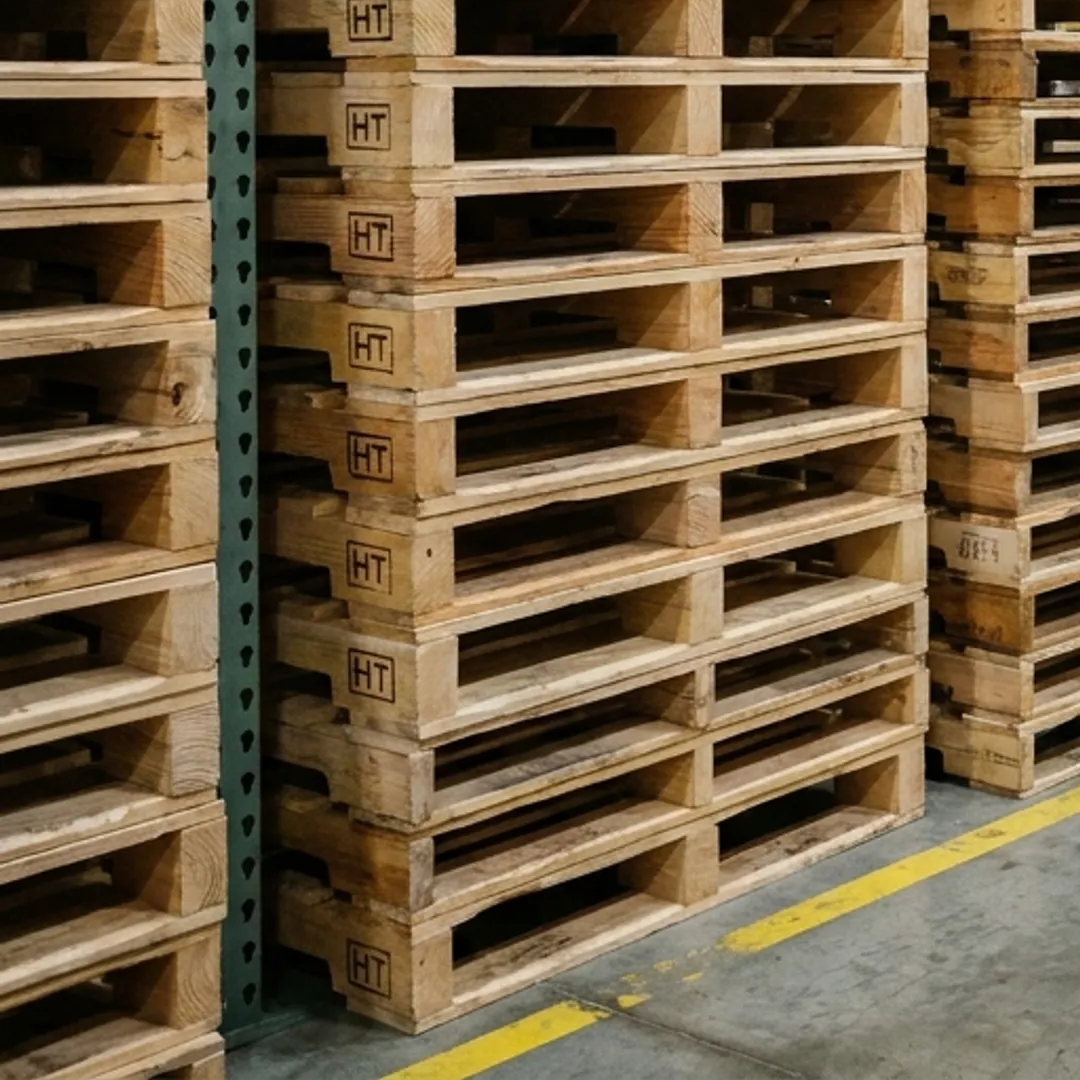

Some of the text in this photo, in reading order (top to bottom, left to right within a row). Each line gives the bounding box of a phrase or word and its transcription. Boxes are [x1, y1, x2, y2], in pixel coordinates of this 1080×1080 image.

[354, 3, 387, 34] HT
[353, 112, 387, 141] HT
[354, 221, 388, 251] HT
[354, 331, 388, 362] HT
[354, 440, 388, 473] HT
[354, 551, 387, 584] HT
[353, 657, 389, 692] HT
[353, 953, 386, 987] HT
